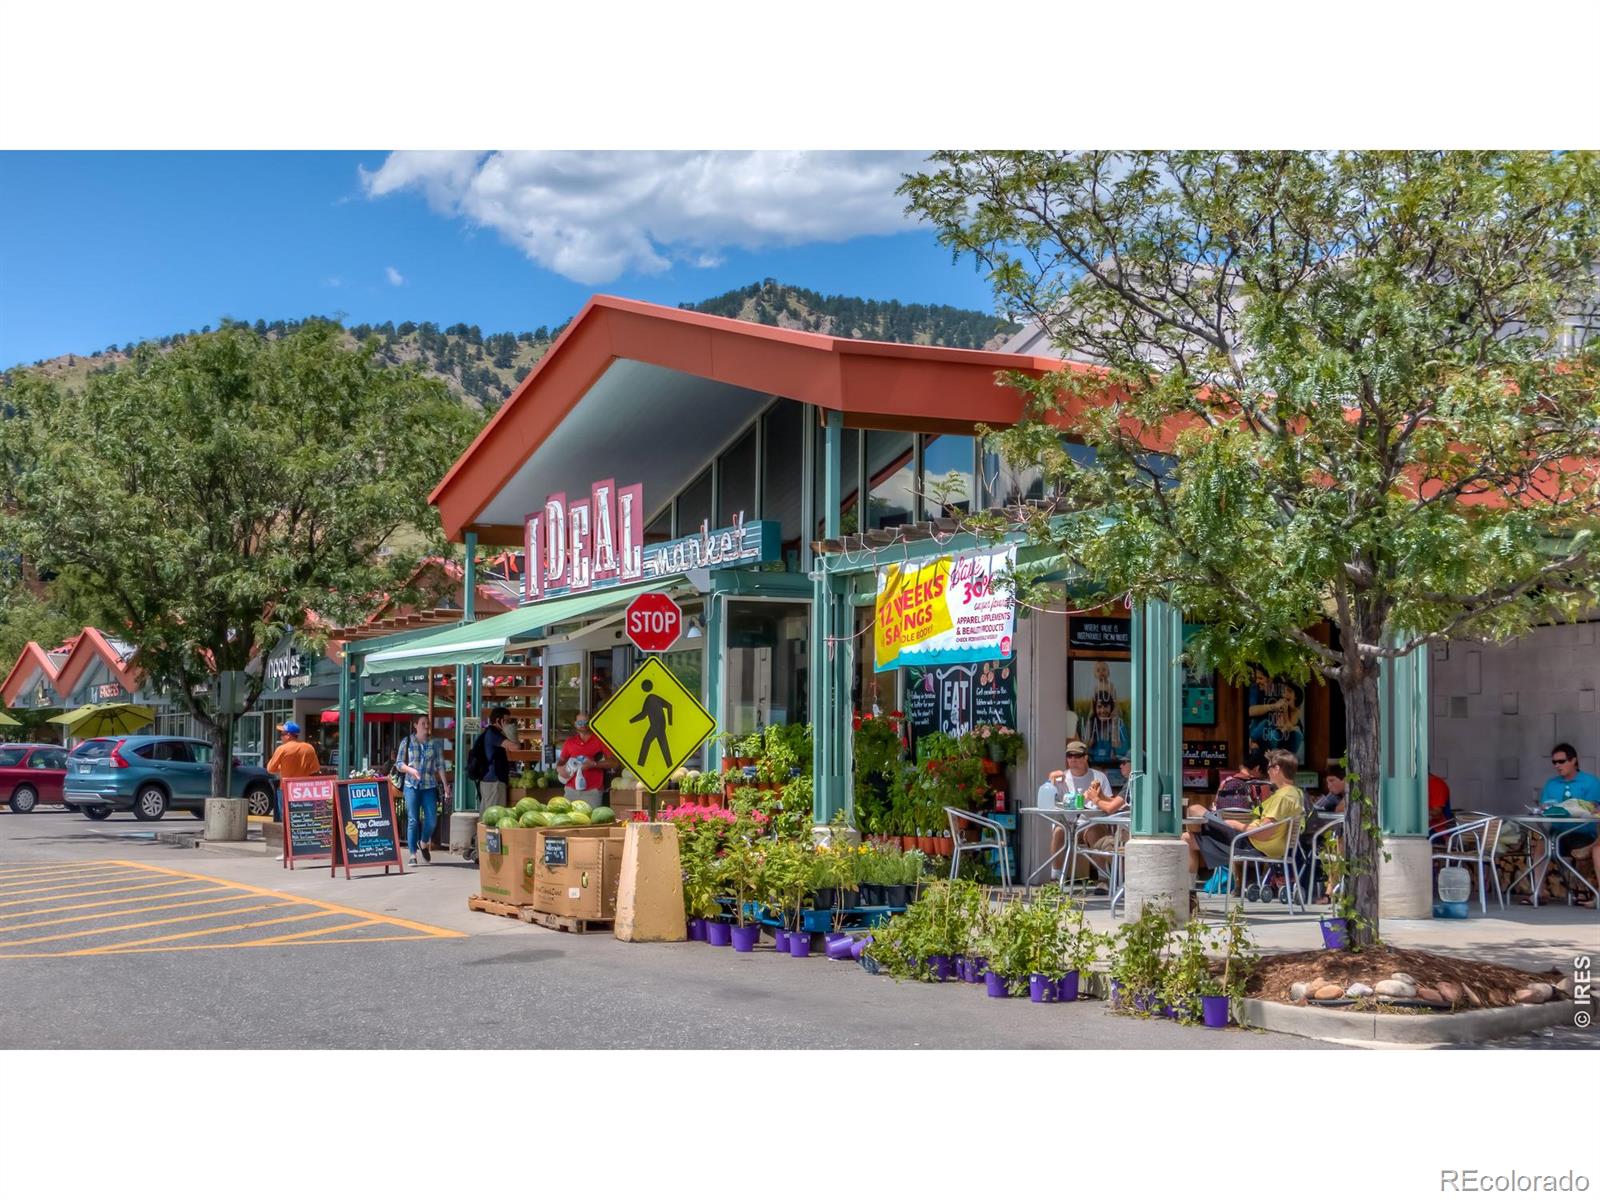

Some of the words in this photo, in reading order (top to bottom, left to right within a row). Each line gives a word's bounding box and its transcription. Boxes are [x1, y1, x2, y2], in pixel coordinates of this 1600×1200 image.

[528, 487, 641, 597] IDEAL
[652, 510, 759, 576] market
[950, 556, 983, 590] Save
[962, 574, 994, 605] 30%
[631, 611, 677, 633] STOP
[879, 601, 893, 629] 12
[885, 604, 932, 646] SANGS
[981, 612, 1011, 622] UPPLEMENTS
[268, 648, 300, 678] noodles
[944, 681, 969, 710] EAT
[1183, 750, 1199, 759] deal
[293, 786, 330, 798] SALE
[352, 788, 376, 798] LOCAL
[357, 821, 367, 829] Ice
[368, 820, 390, 828] Cream
[359, 829, 379, 837] Social
